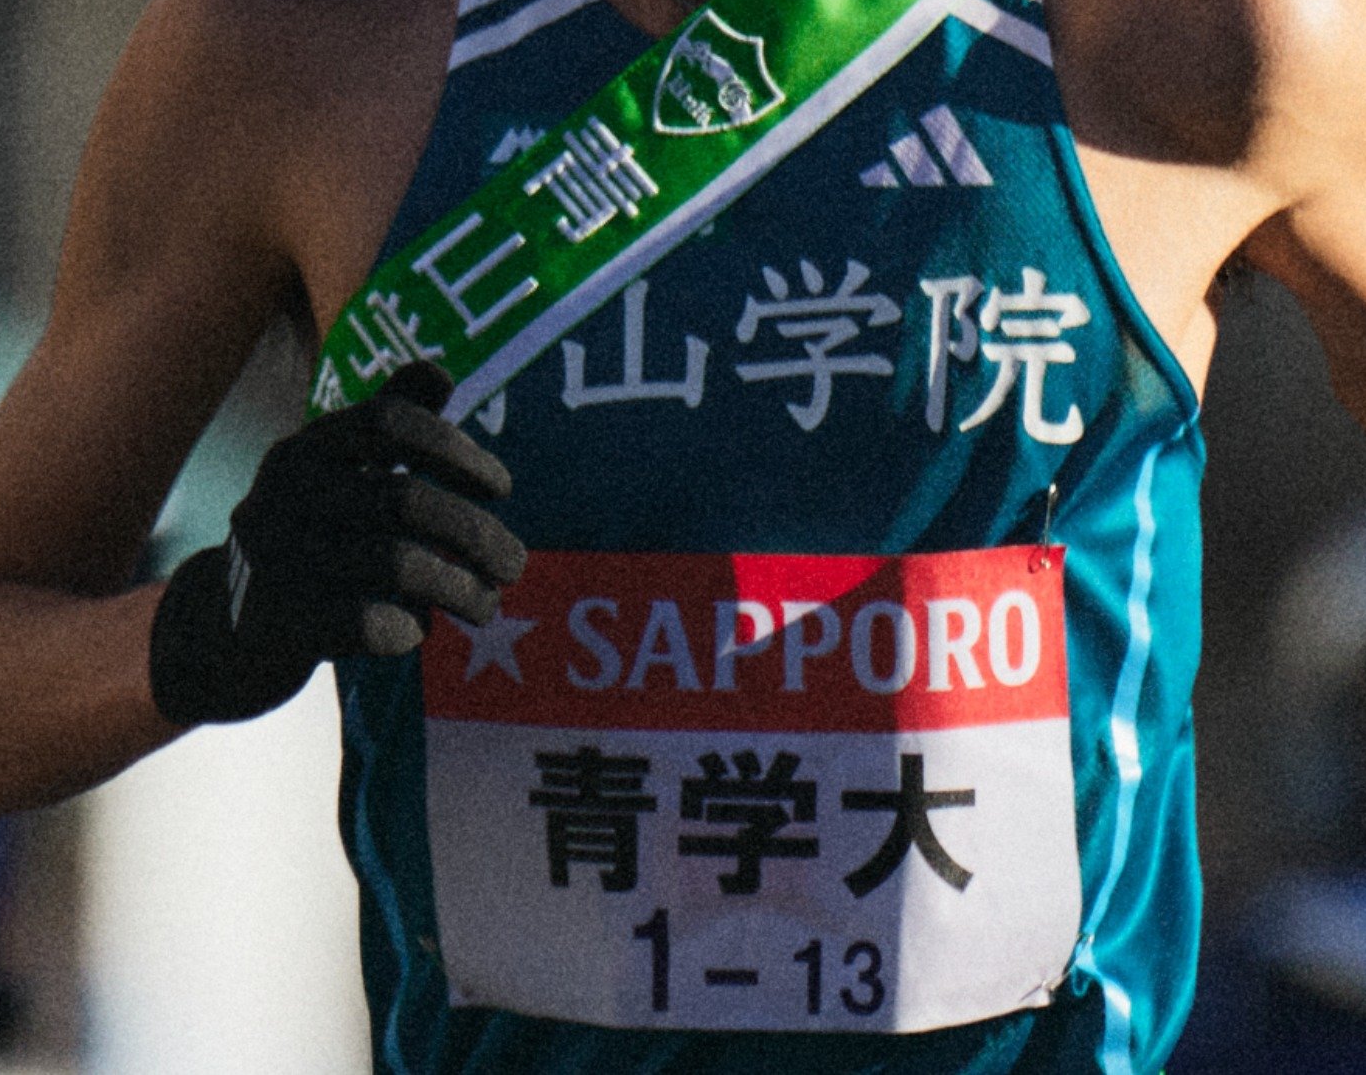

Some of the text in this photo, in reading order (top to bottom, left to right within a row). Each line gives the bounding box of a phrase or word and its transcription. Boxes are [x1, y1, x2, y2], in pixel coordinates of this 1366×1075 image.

[475, 258, 1093, 446] 山学院
[566, 588, 1041, 693] SAPPORO
[527, 745, 977, 899] 青学大
